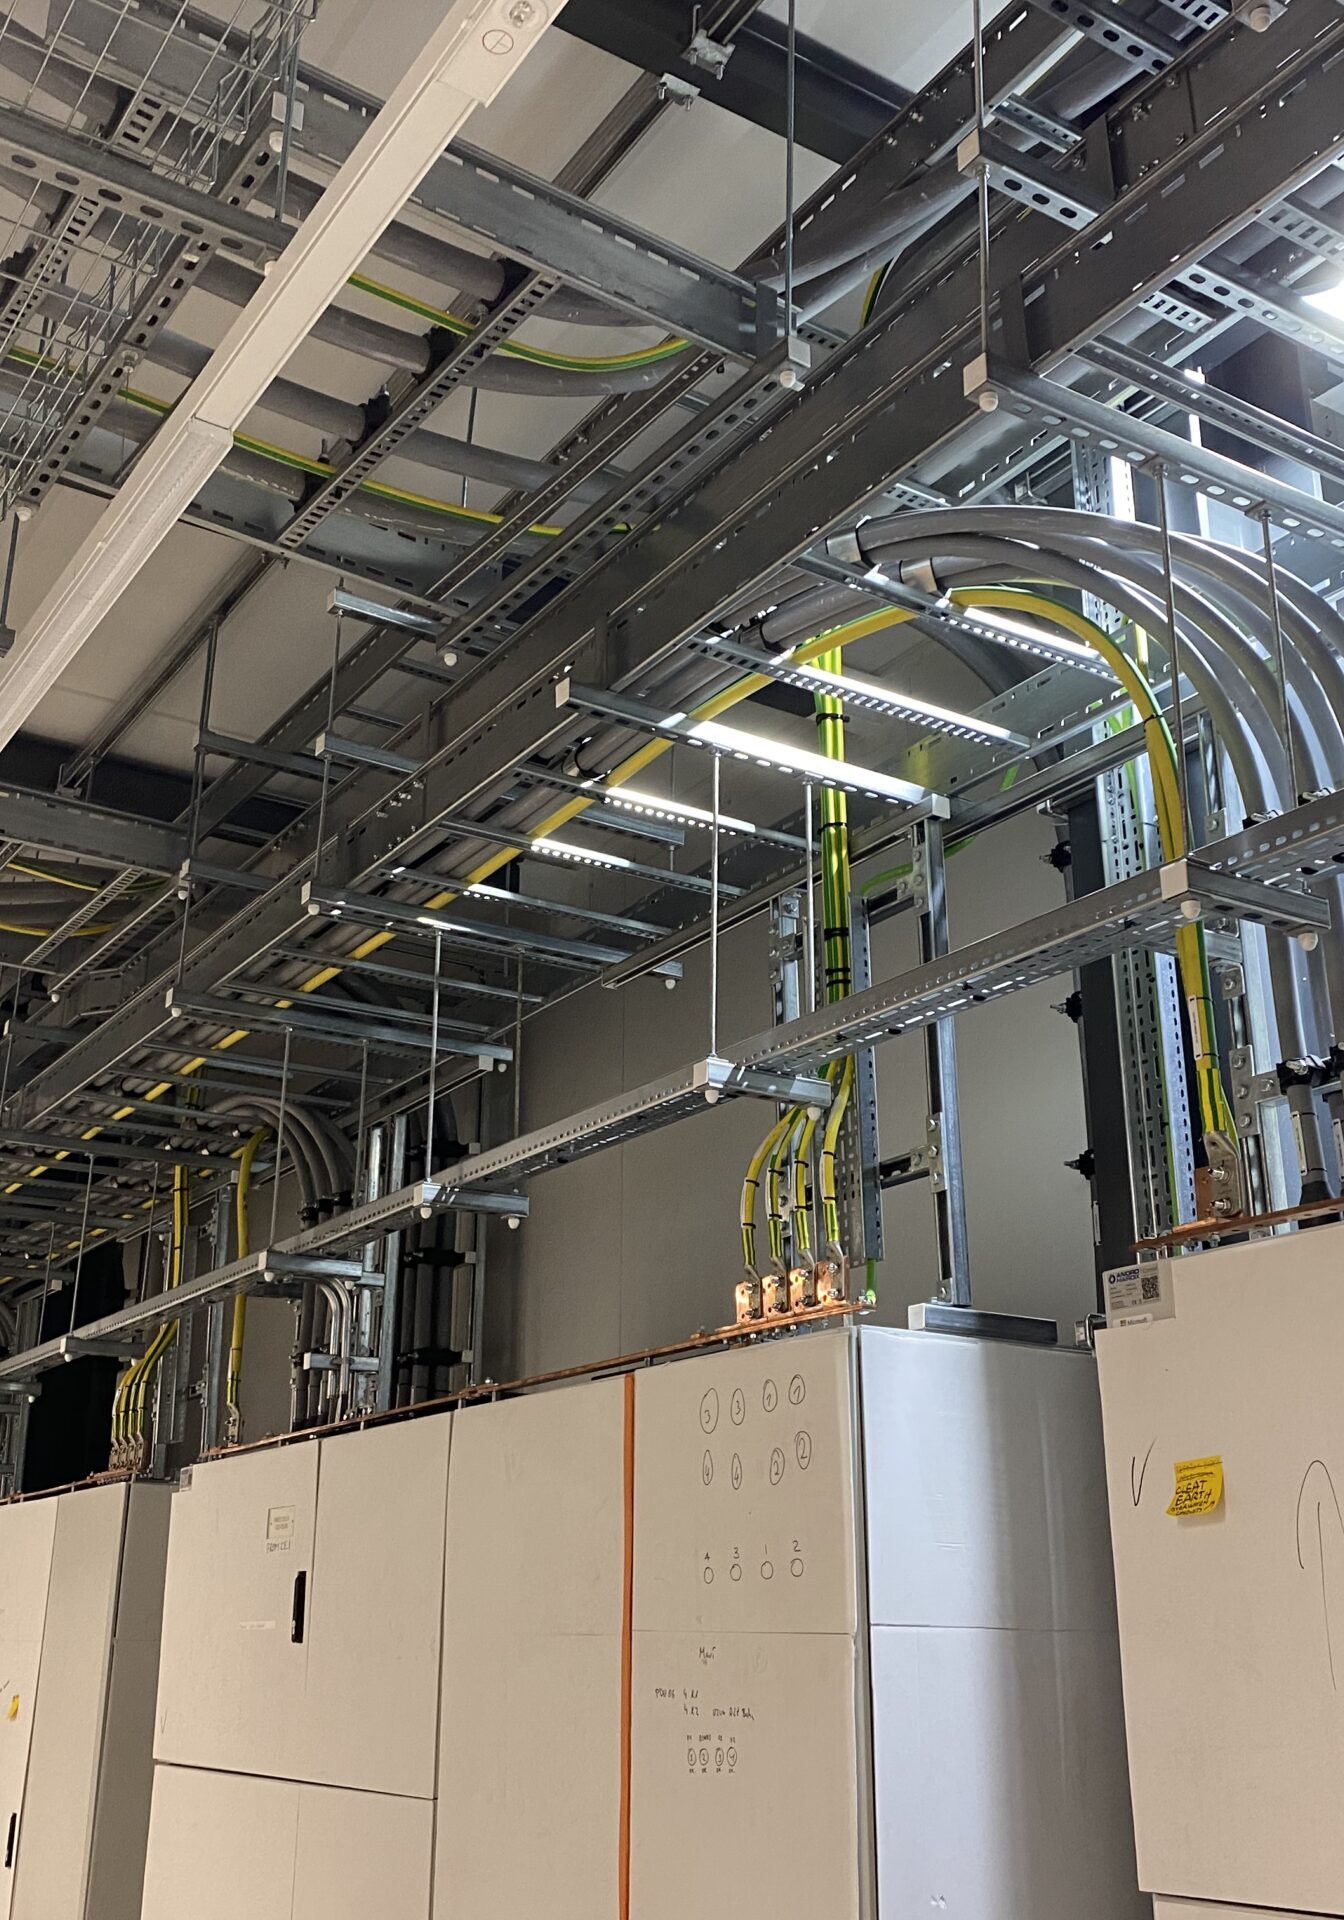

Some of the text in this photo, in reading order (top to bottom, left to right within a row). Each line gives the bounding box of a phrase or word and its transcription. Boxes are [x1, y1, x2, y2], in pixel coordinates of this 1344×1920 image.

[1175, 1480, 1208, 1494] CLEAT
[1175, 1488, 1213, 1506] EARTH
[704, 1552, 711, 1561] 4
[733, 1546, 740, 1559] 3
[792, 1540, 802, 1553] 2
